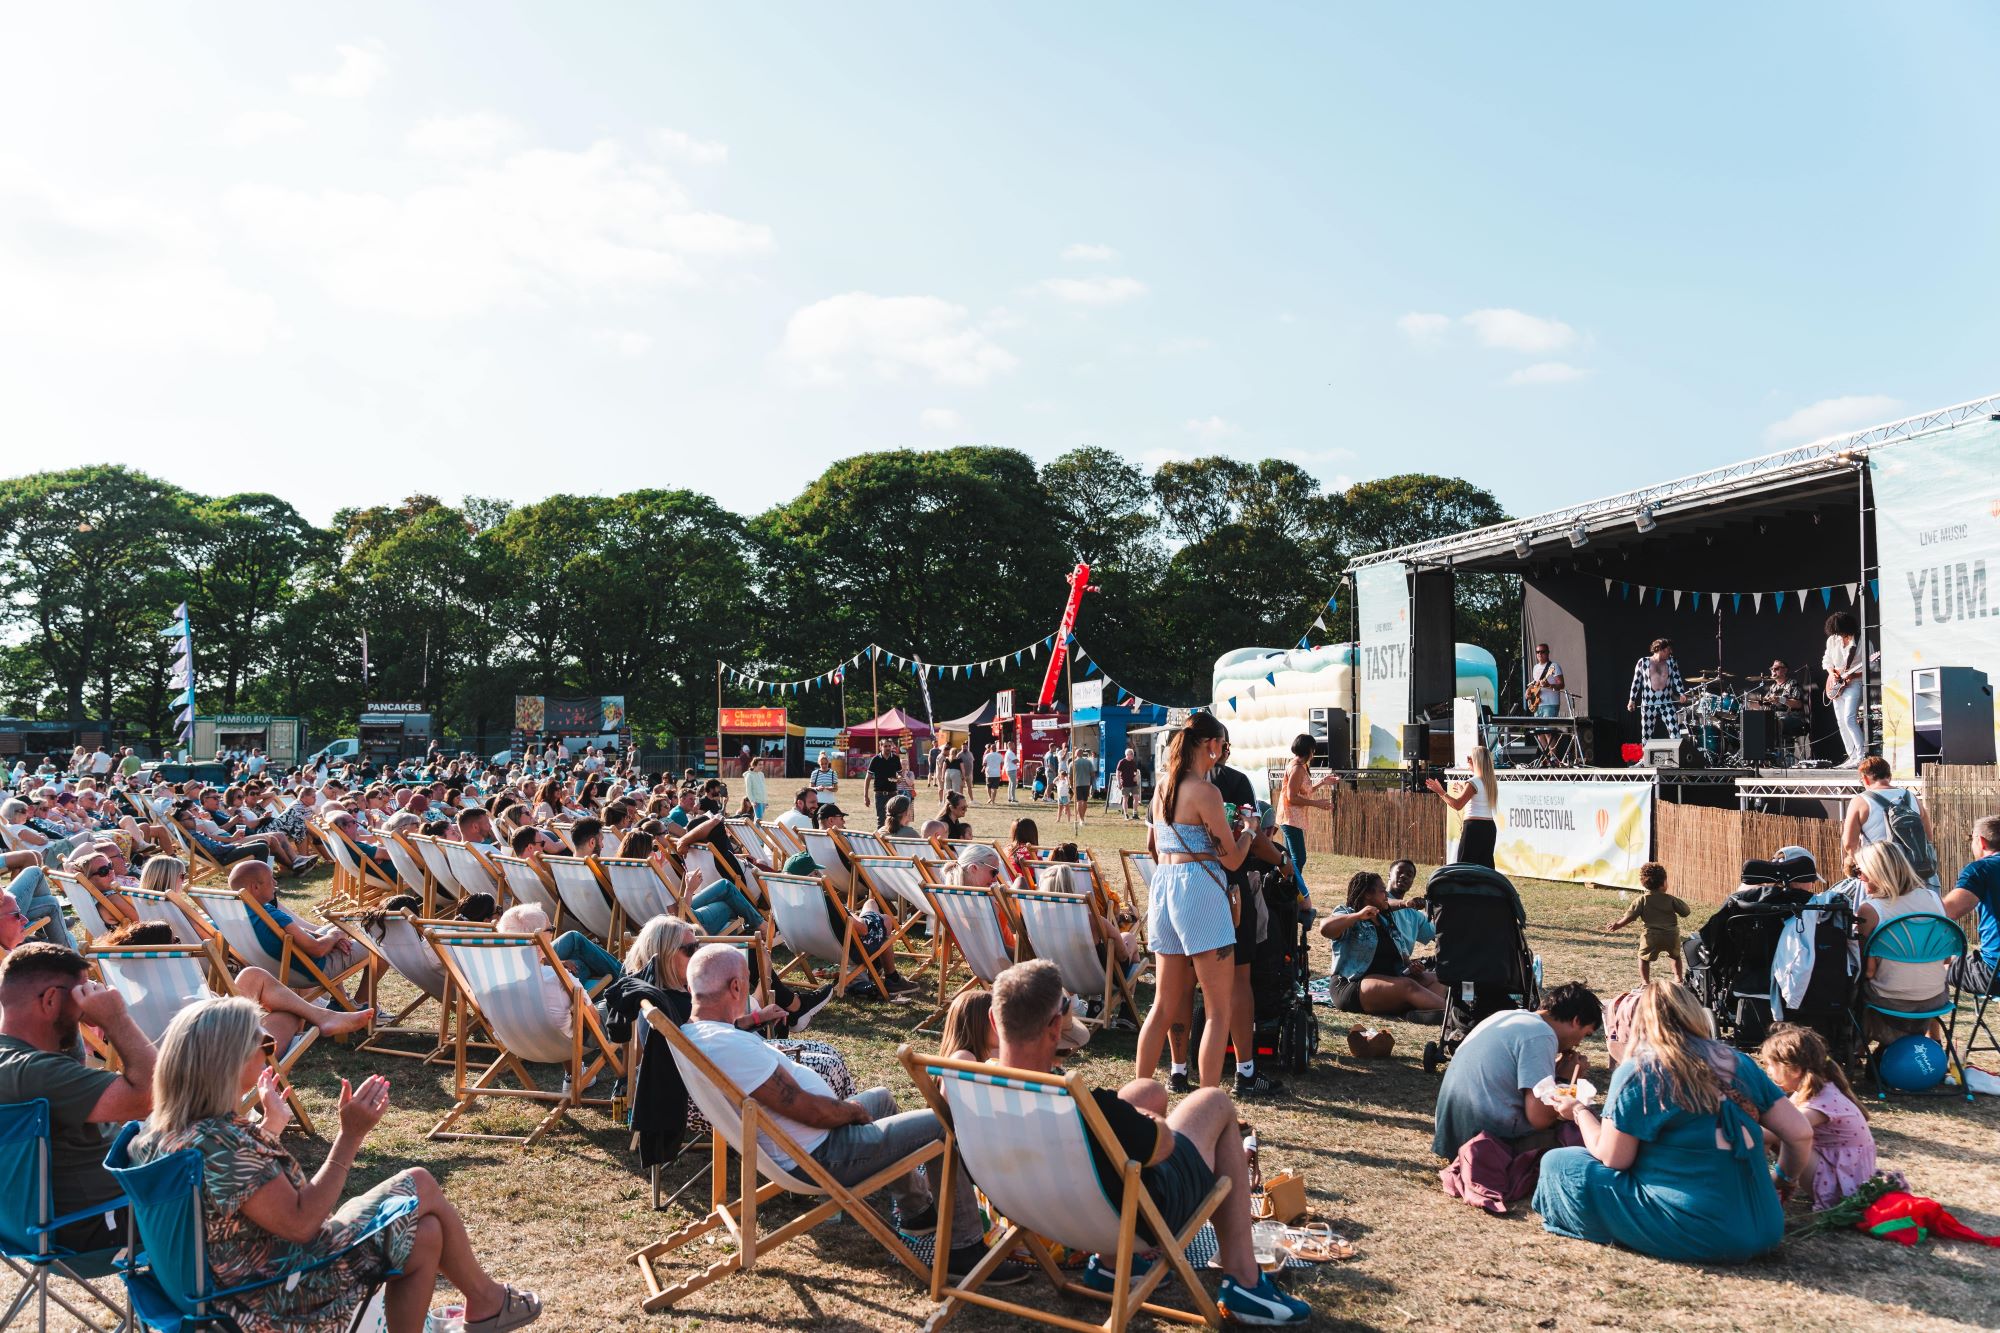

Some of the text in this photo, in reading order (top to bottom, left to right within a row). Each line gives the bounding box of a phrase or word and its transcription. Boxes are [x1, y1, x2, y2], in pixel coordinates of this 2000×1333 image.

[1920, 523, 1968, 546] LIVE MUSIC
[1906, 560, 1999, 626] YUM.
[1057, 603, 1076, 649] PZA
[1365, 642, 1407, 681] TASTY.
[367, 703, 422, 711] PANCAKES
[734, 710, 765, 719] Churros
[216, 715, 271, 724] BAMBOO BOX
[734, 719, 772, 727] Chocolate
[1509, 807, 1576, 831] FOOD FESTIVAL
